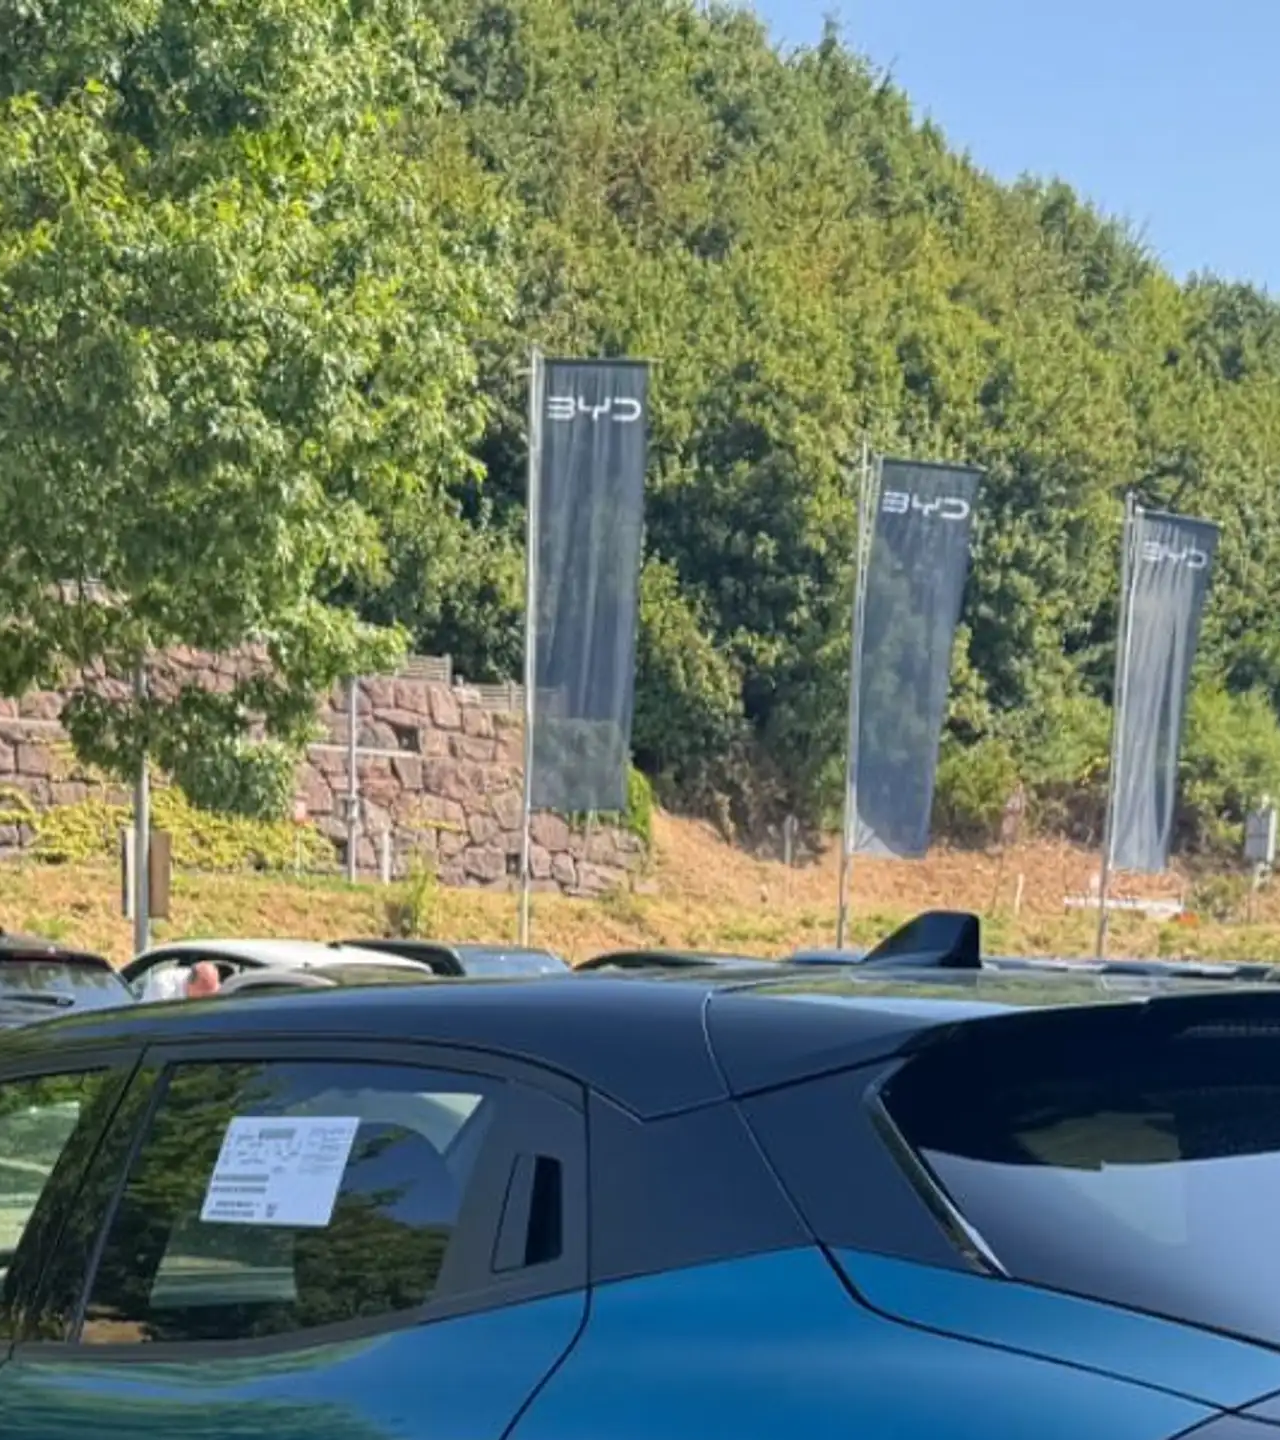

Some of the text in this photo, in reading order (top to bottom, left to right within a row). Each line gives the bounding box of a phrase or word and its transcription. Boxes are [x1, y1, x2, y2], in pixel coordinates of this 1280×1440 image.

[546, 394, 642, 422] BYD
[881, 488, 970, 520] BYD
[1141, 540, 1208, 569] BYD
